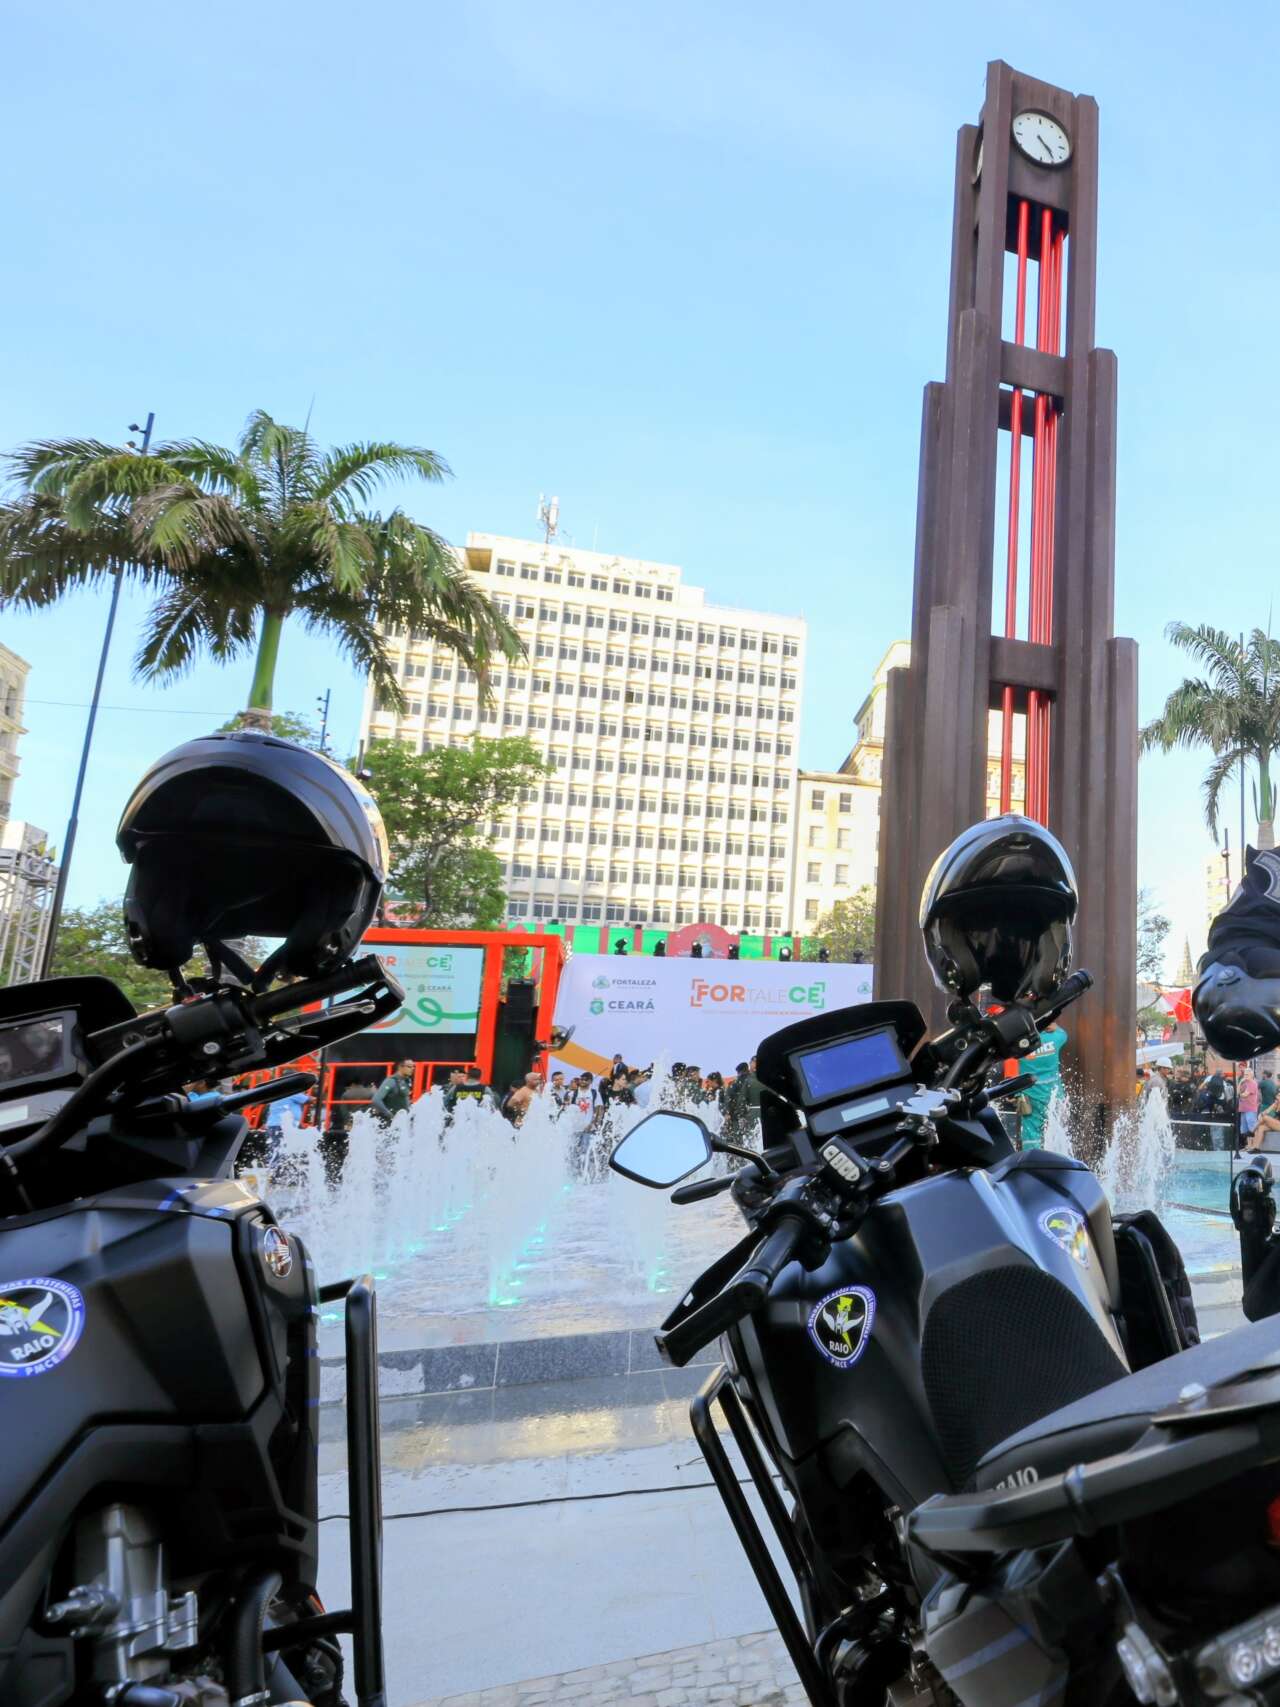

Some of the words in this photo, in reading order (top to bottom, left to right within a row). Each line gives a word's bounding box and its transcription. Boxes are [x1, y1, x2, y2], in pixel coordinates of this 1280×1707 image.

[608, 998, 655, 1010] CEARÁ
[10, 1335, 54, 1360] RAIO
[829, 1341, 849, 1354] RAIO
[25, 1355, 60, 1376] PMCE
